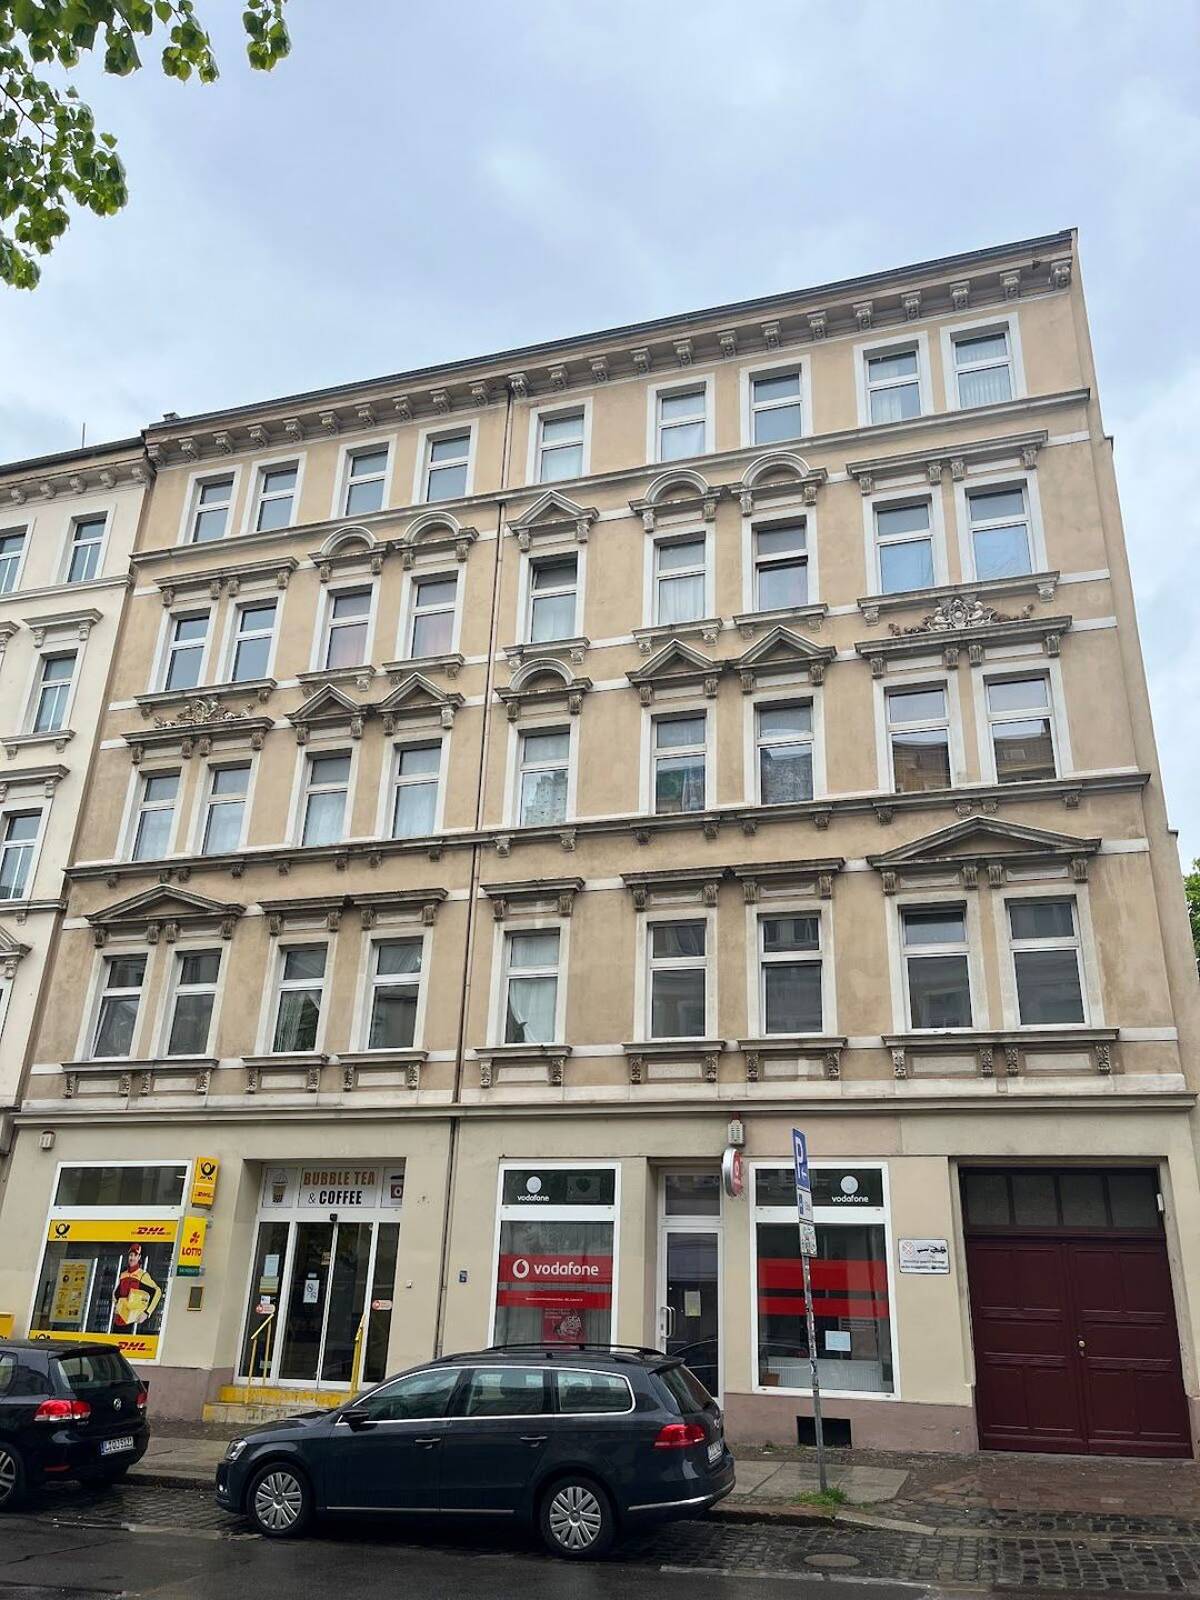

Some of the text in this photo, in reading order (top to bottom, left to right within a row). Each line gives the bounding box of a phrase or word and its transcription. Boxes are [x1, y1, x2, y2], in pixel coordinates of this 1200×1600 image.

[795, 1136, 803, 1179] P
[303, 1171, 376, 1186] BUBBLE TEA
[308, 1190, 363, 1205] & COFFEE
[517, 1194, 550, 1202] vodafone
[136, 1227, 165, 1235] DHL
[181, 1246, 202, 1257] LOTTO
[533, 1261, 599, 1276] vodafone
[117, 1341, 146, 1351] DHL
